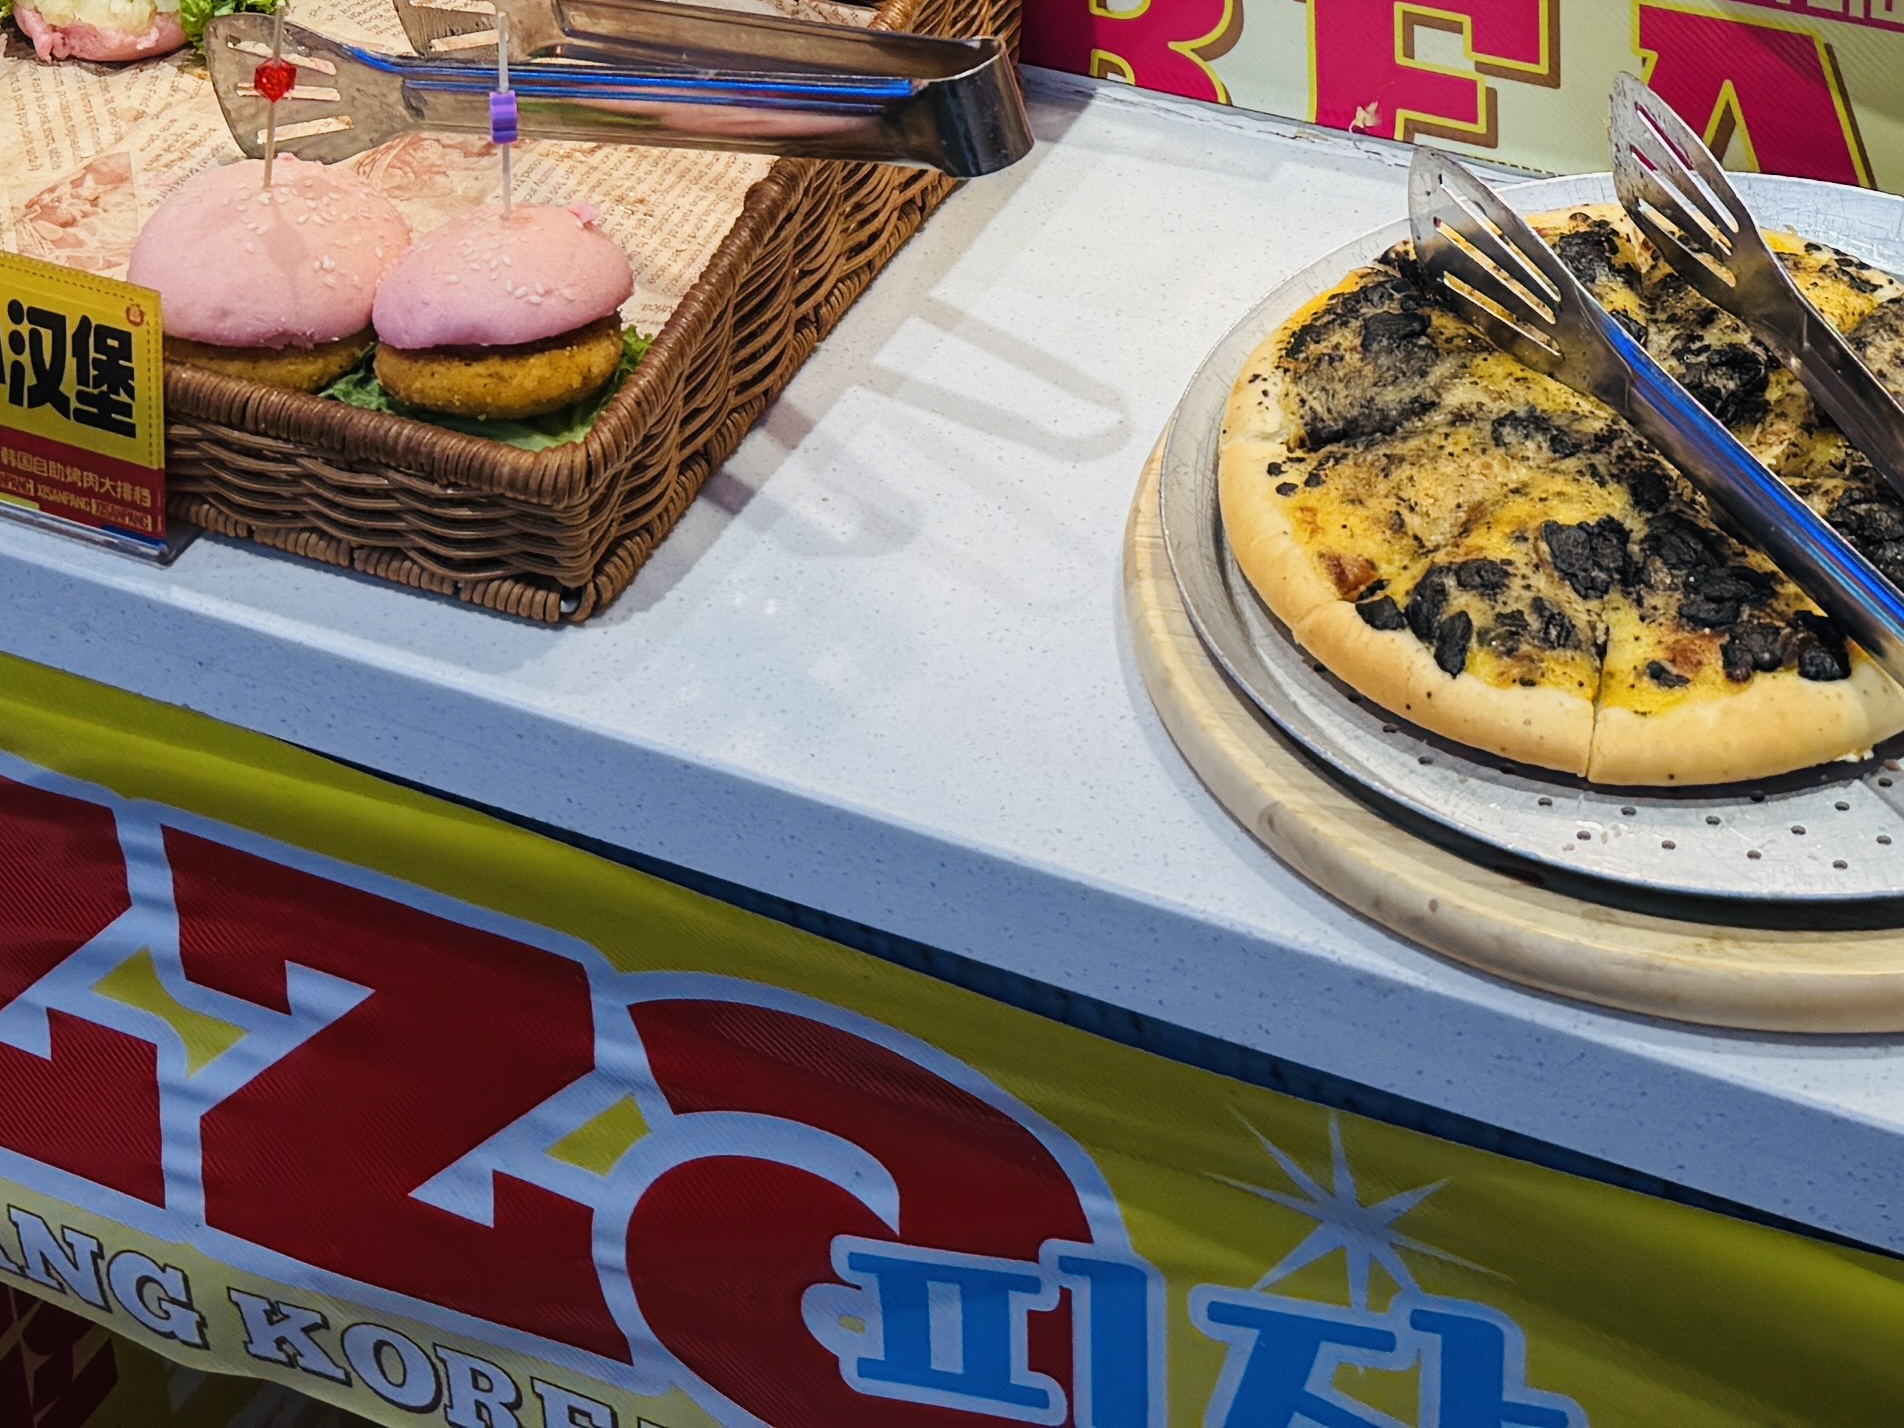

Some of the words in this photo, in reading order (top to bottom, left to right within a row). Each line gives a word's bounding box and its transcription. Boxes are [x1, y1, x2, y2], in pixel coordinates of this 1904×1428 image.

[0, 444, 153, 508] 韩国自助烤肉大排档
